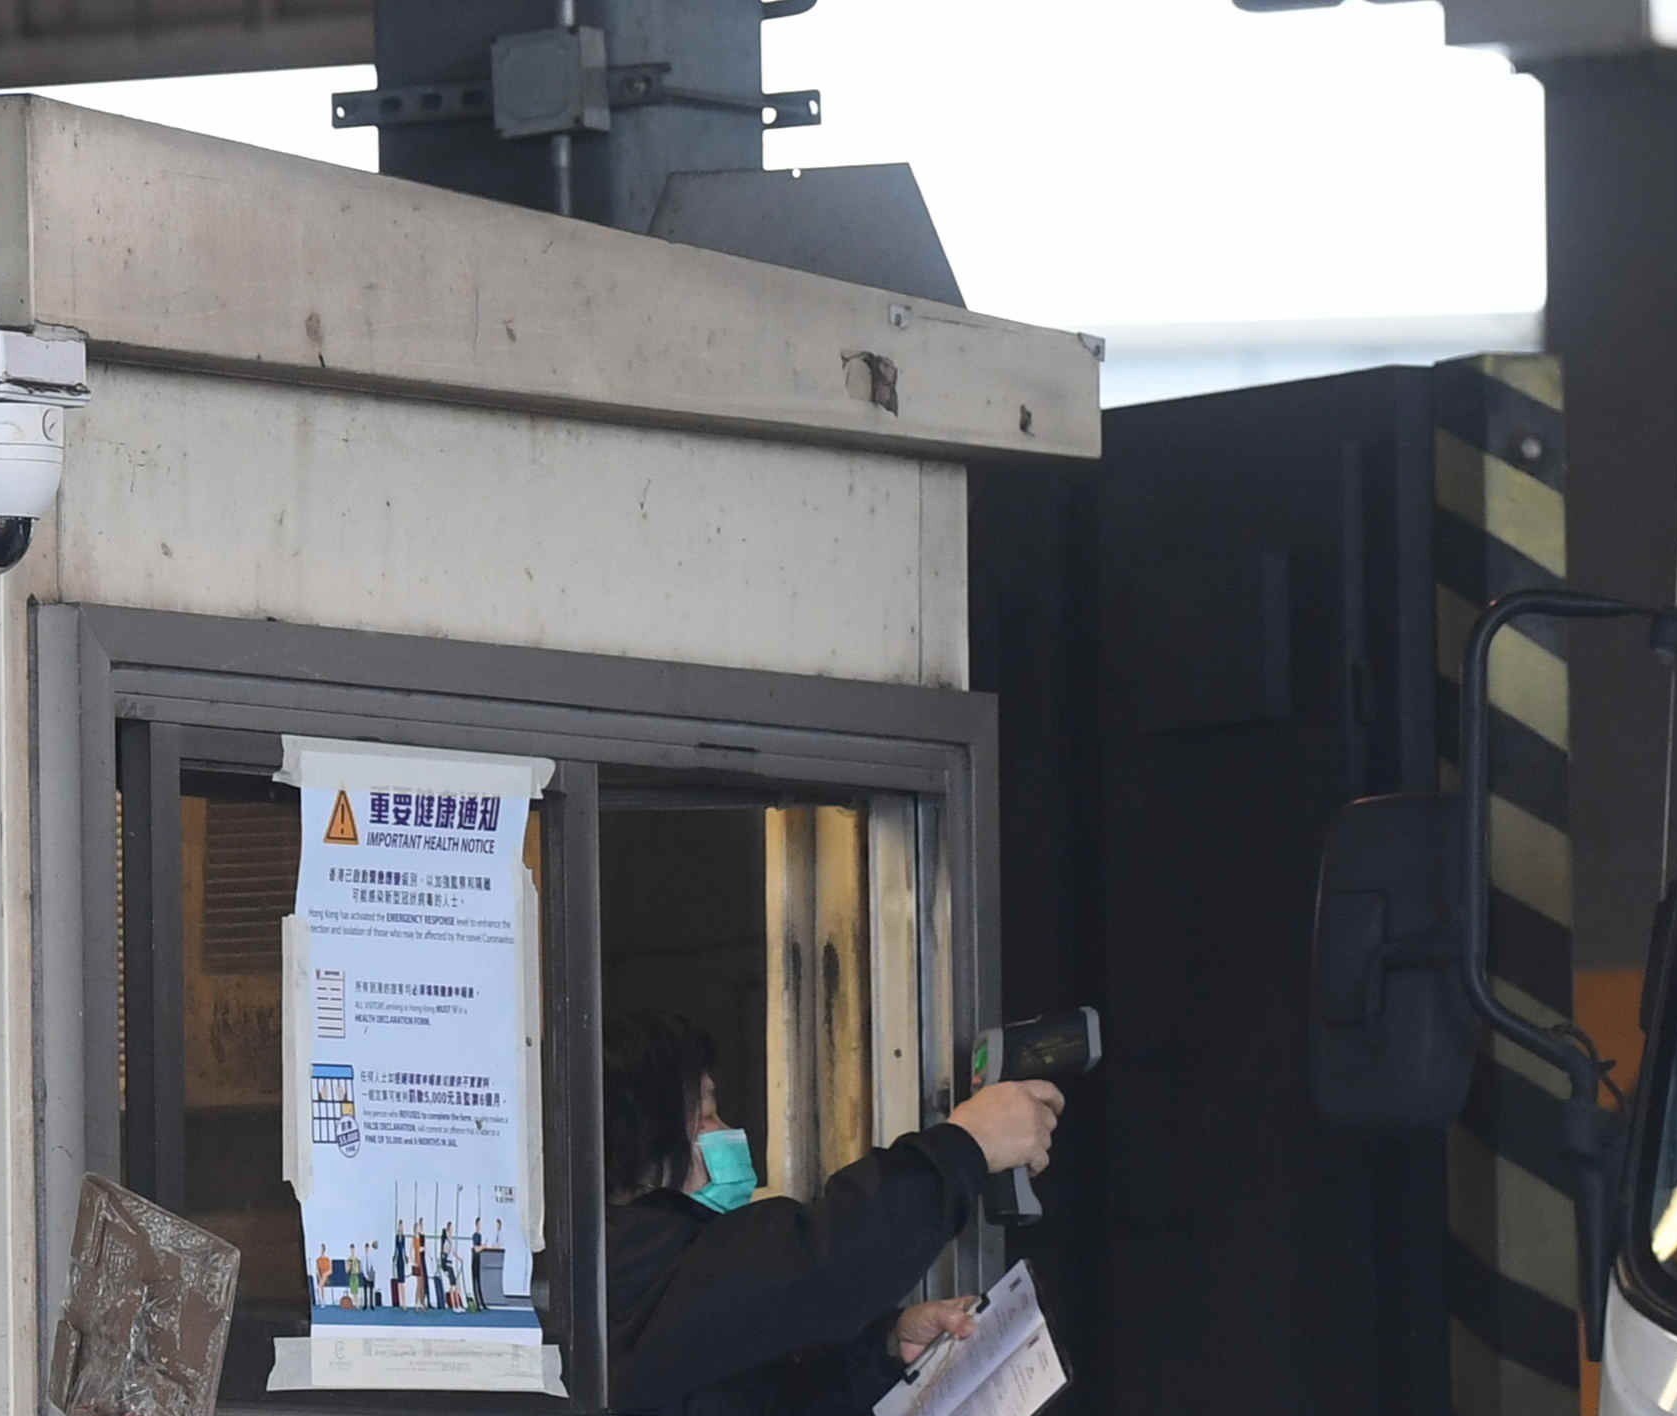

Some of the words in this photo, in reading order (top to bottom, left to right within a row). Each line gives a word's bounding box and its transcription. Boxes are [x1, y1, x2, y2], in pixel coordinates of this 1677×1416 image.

[369, 792, 500, 831] 重要健康通知
[367, 832, 422, 849] IMPORTANT
[425, 835, 459, 852] HEALTH
[462, 838, 495, 854] NOTICE
